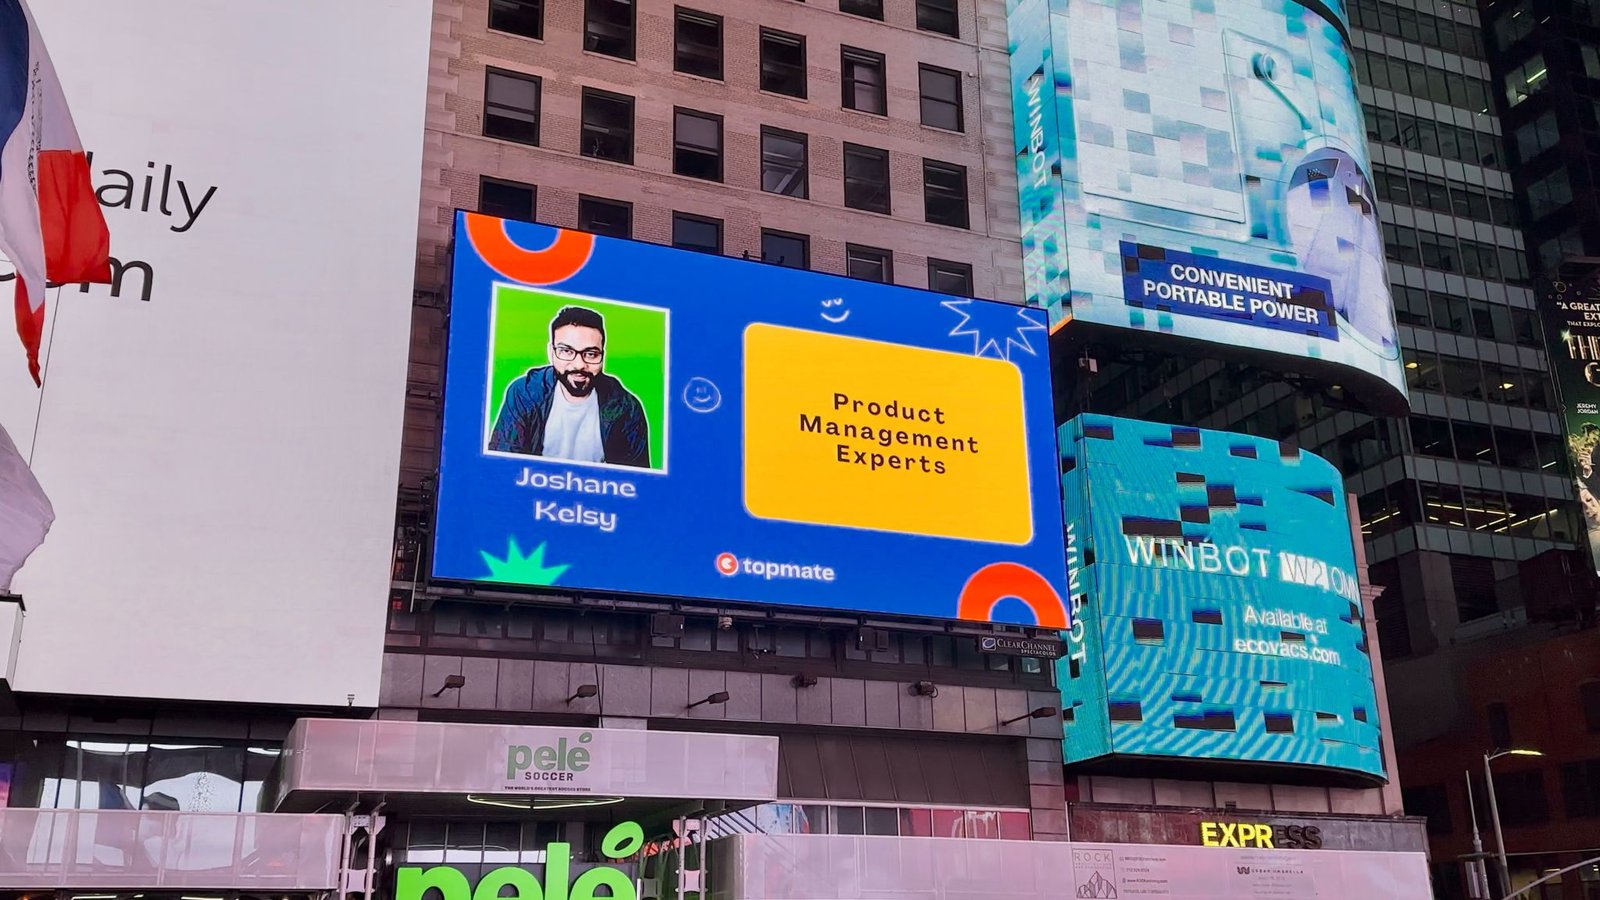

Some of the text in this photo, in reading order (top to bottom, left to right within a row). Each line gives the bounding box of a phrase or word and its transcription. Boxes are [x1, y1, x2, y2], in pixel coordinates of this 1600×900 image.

[1027, 77, 1048, 189] WINBOT
[87, 151, 218, 233] aily
[1170, 264, 1294, 300] CONVENIENT
[1143, 279, 1320, 325] PORTABLE POWER
[833, 392, 946, 424] Product
[799, 413, 979, 453] Management
[836, 444, 947, 475] Experts
[515, 466, 637, 498] Joshane
[533, 500, 617, 532] Kelsy
[742, 556, 836, 582] topmate
[1124, 534, 1271, 578] WINBOT
[1244, 605, 1328, 634] Available at
[1233, 638, 1341, 665] ecovacs.com
[507, 732, 593, 780] pelé
[525, 772, 574, 781] SOCCER
[1200, 822, 1323, 850] EXPRESS
[1074, 852, 1111, 862] ROCK
